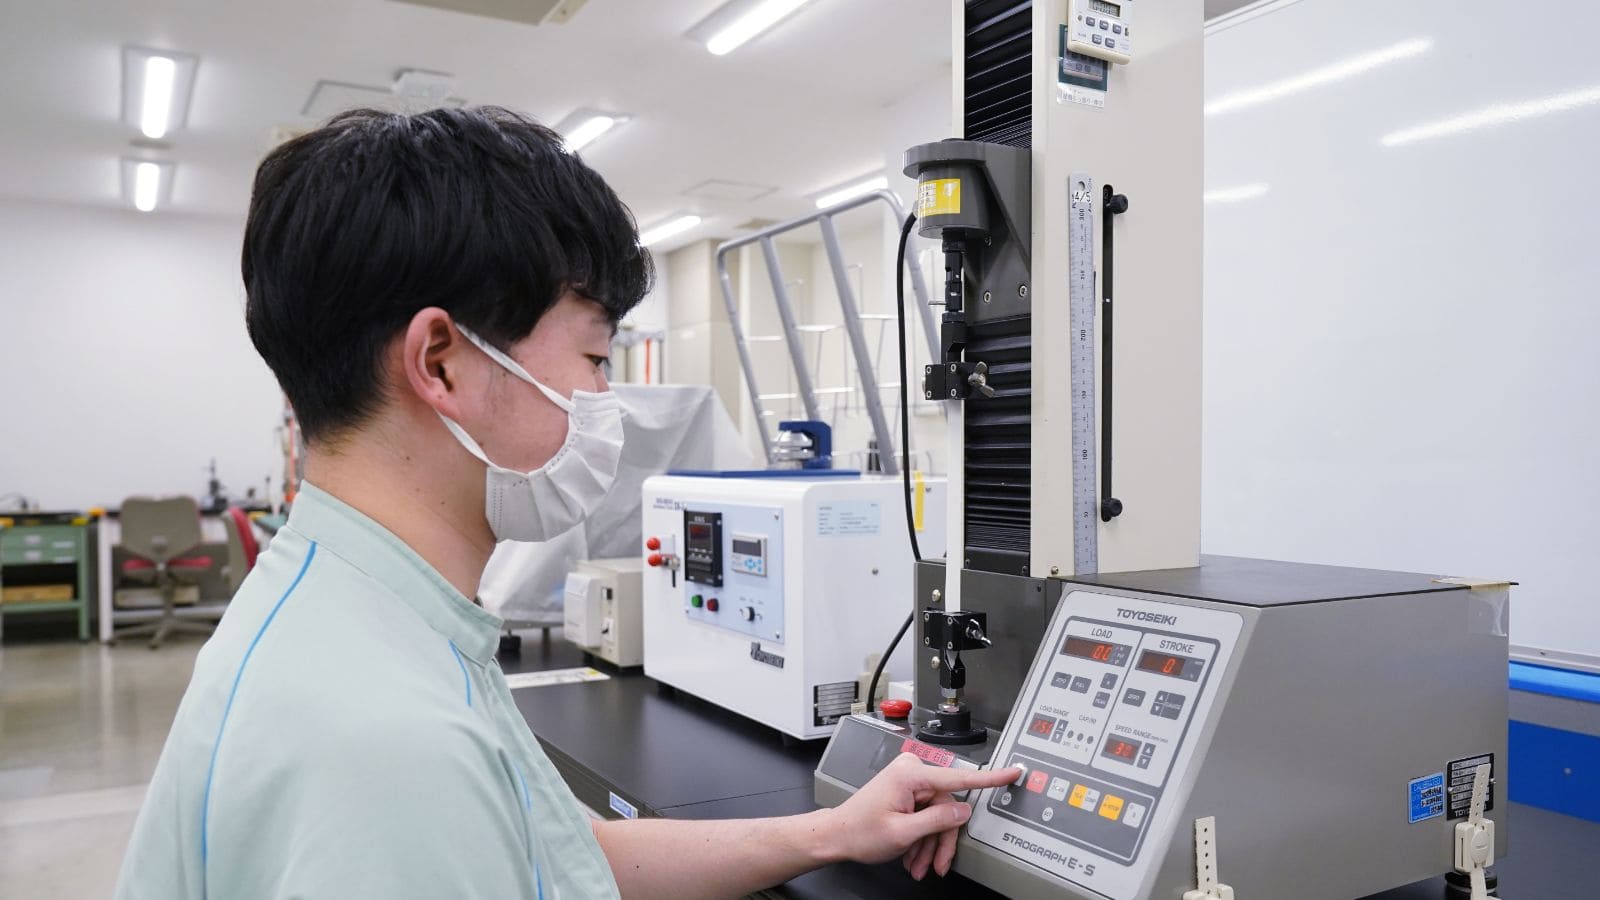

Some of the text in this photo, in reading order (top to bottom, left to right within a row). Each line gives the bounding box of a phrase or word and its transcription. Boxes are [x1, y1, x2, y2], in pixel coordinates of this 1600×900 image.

[1116, 608, 1177, 626] TOYOSEIKI
[1091, 627, 1113, 639] LOAD
[1159, 639, 1195, 654] STROKE
[1115, 724, 1132, 734] SPEED
[1132, 728, 1151, 739] RANGE
[1002, 832, 1067, 866] STROGRAPH
